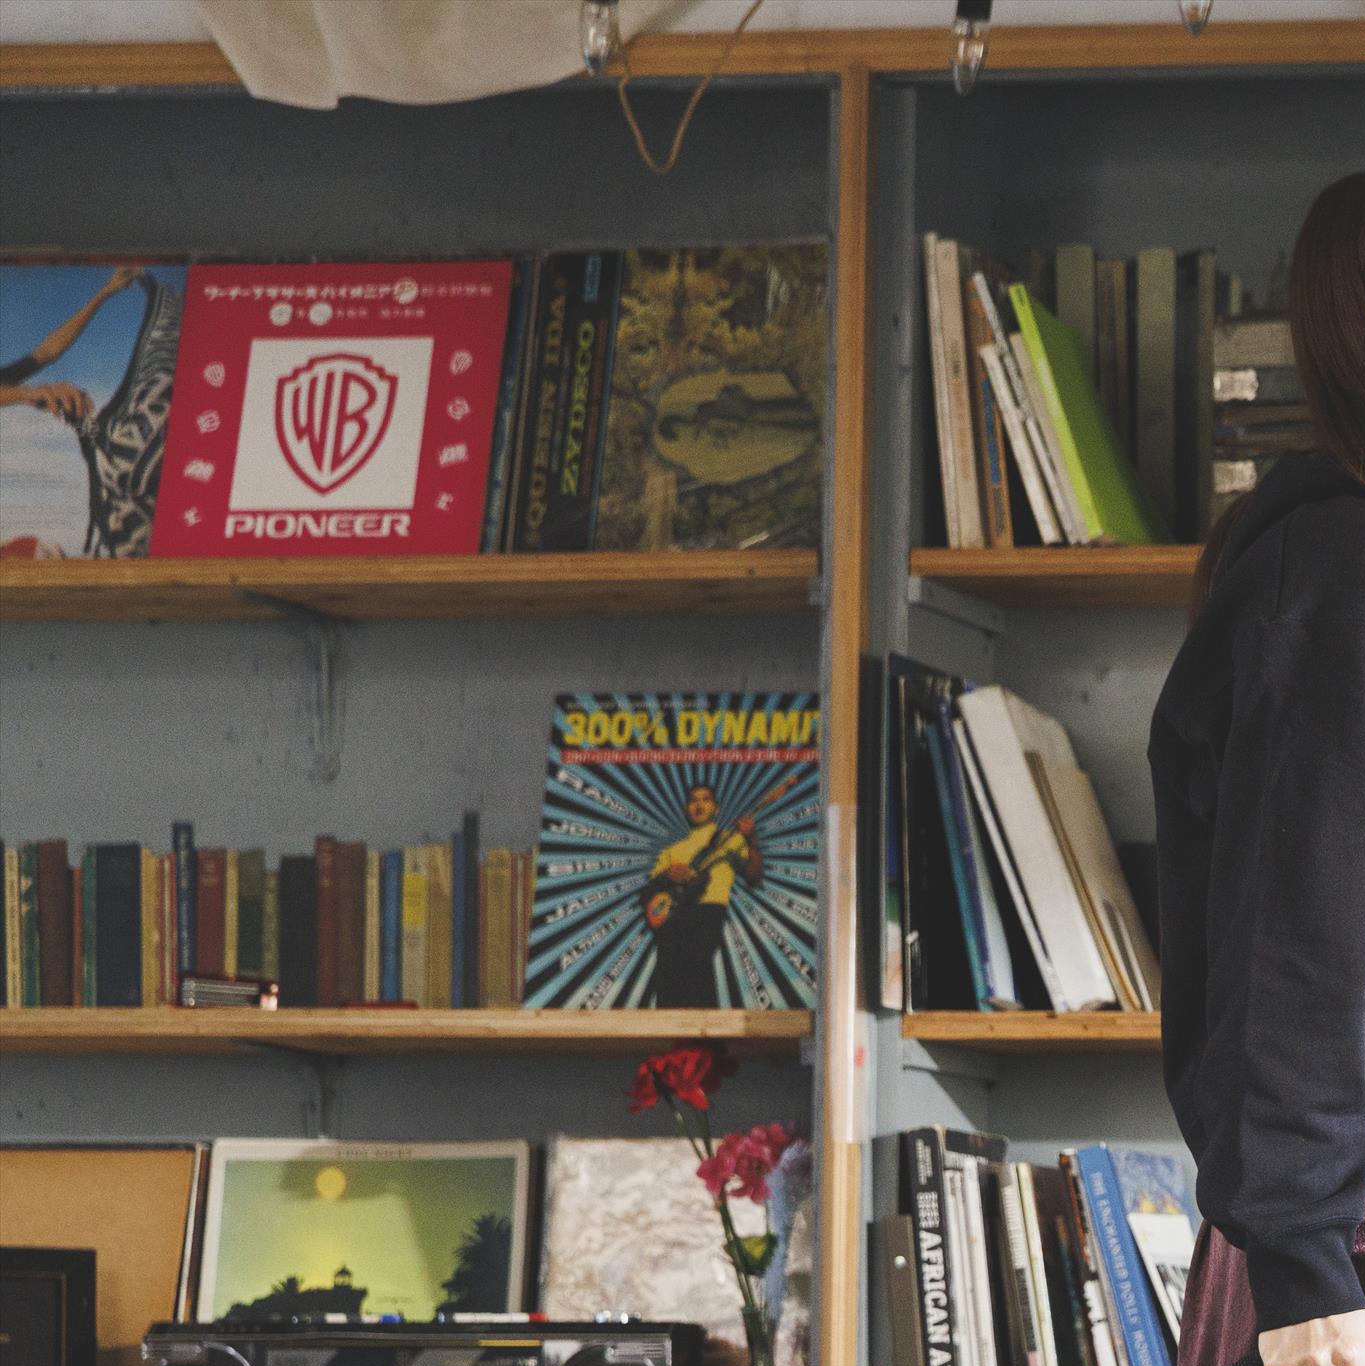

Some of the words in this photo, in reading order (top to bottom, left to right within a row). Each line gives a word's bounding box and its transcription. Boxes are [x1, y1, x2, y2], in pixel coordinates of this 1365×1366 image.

[559, 319, 596, 497] ZYDECO
[224, 512, 412, 540] PIONEER
[562, 709, 671, 748] 300%
[919, 1229, 951, 1345] AFRICAN
